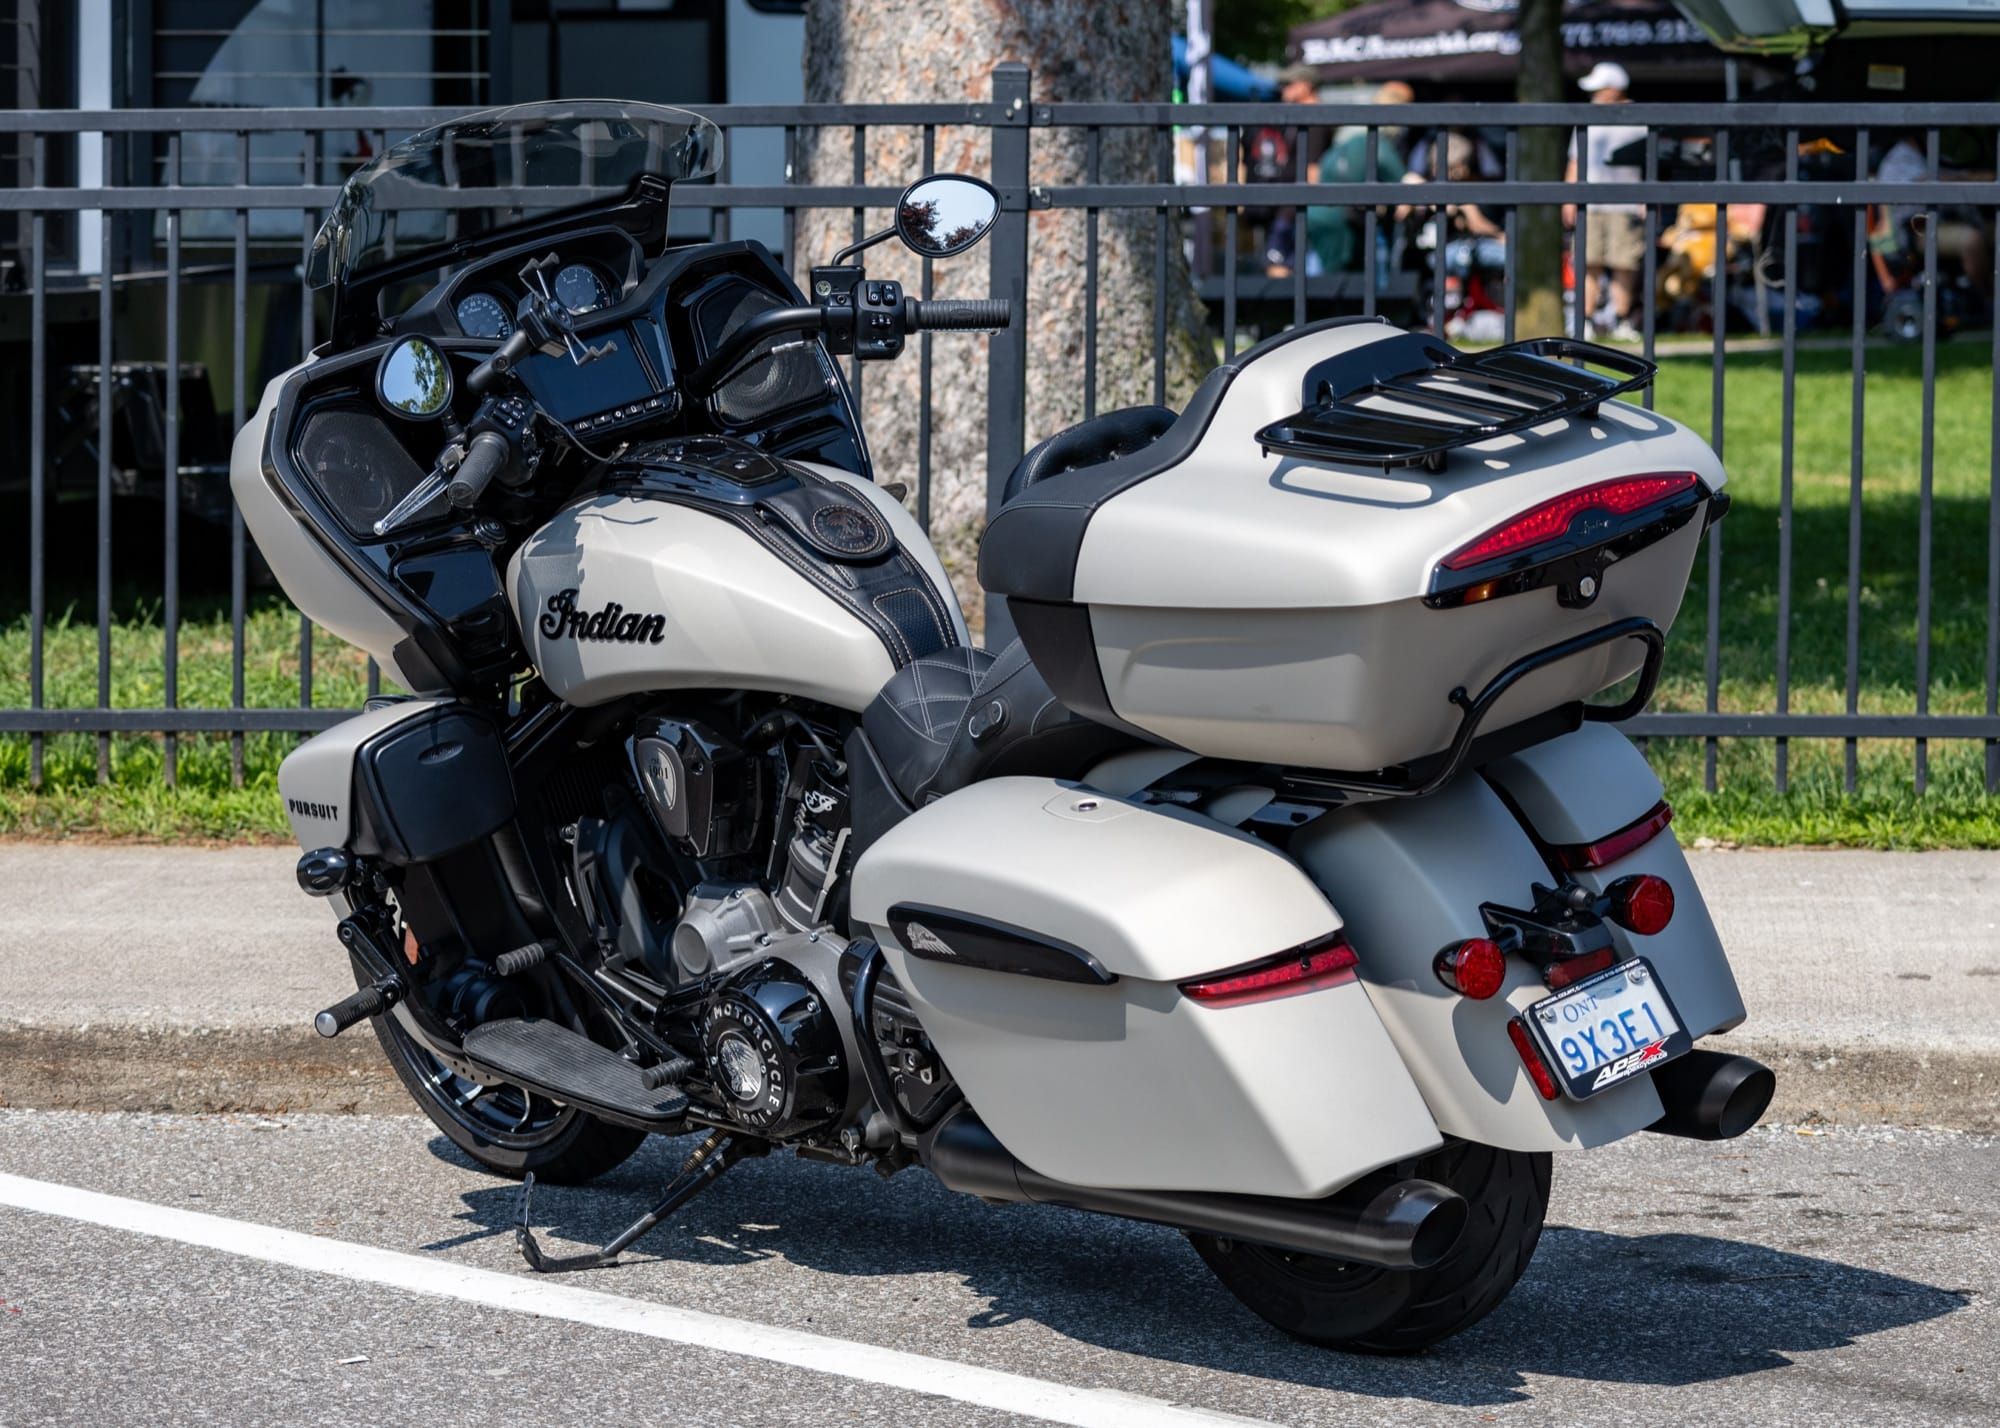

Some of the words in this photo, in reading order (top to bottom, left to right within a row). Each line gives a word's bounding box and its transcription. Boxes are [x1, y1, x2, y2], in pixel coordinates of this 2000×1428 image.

[540, 588, 666, 645] Indian
[288, 798, 338, 821] PURSUIT
[1563, 994, 1598, 1023] ONT
[713, 1003, 782, 1108] MOTORCYCLE
[1560, 1001, 1665, 1073] 9X3E1
[1591, 1036, 1670, 1091] APEX
